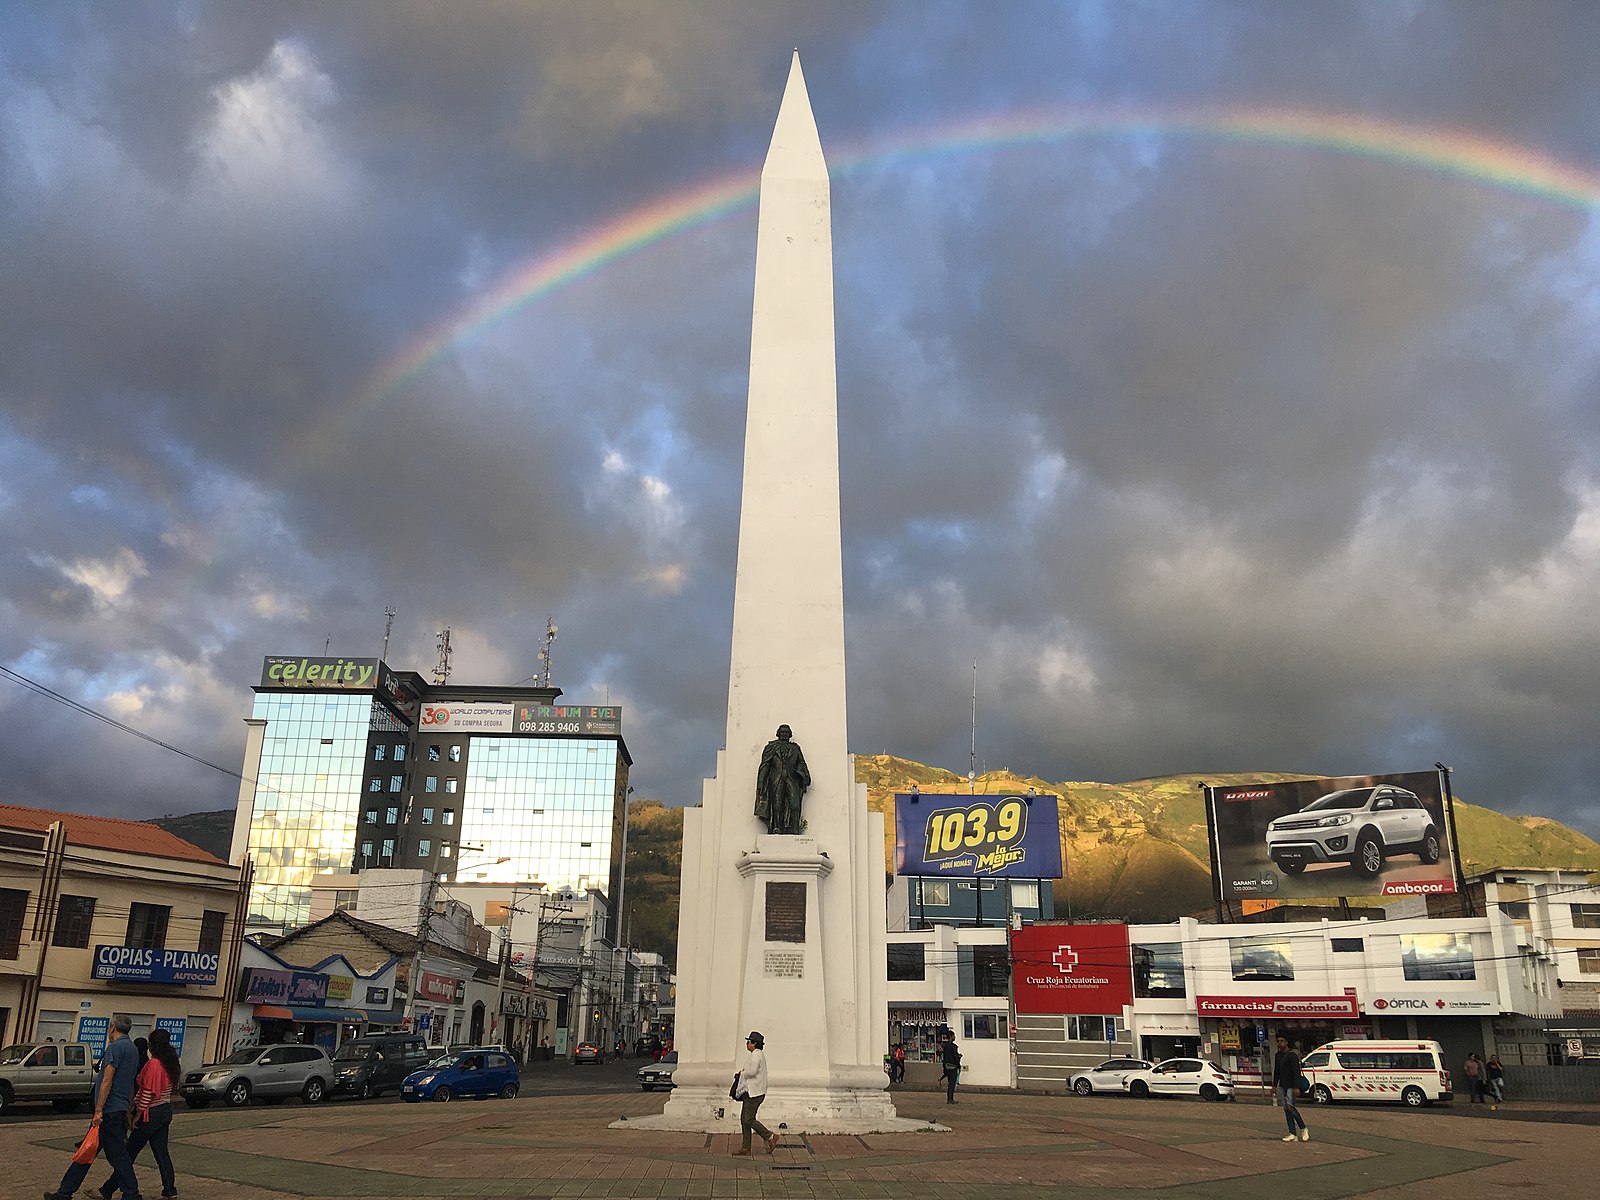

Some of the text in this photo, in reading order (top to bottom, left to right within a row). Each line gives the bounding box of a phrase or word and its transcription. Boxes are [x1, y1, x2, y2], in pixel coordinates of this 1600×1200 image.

[268, 659, 373, 686] celerity
[538, 707, 616, 718] PREMIUM LEVEL
[519, 721, 580, 732] 098 285 9406
[930, 803, 1021, 853] 103.9
[996, 845, 1007, 854] la
[99, 946, 153, 966] COPIAS
[163, 951, 218, 970] PLANOS
[116, 967, 152, 975] COPICOM
[173, 972, 216, 981] AUTOCAD
[1026, 976, 1109, 985] Cruz Roja Ecuatoriana
[1200, 1001, 1348, 1012] farmacias económicas
[1389, 998, 1428, 1008] ÓPTICA
[906, 1010, 947, 1020] IMBABURA
